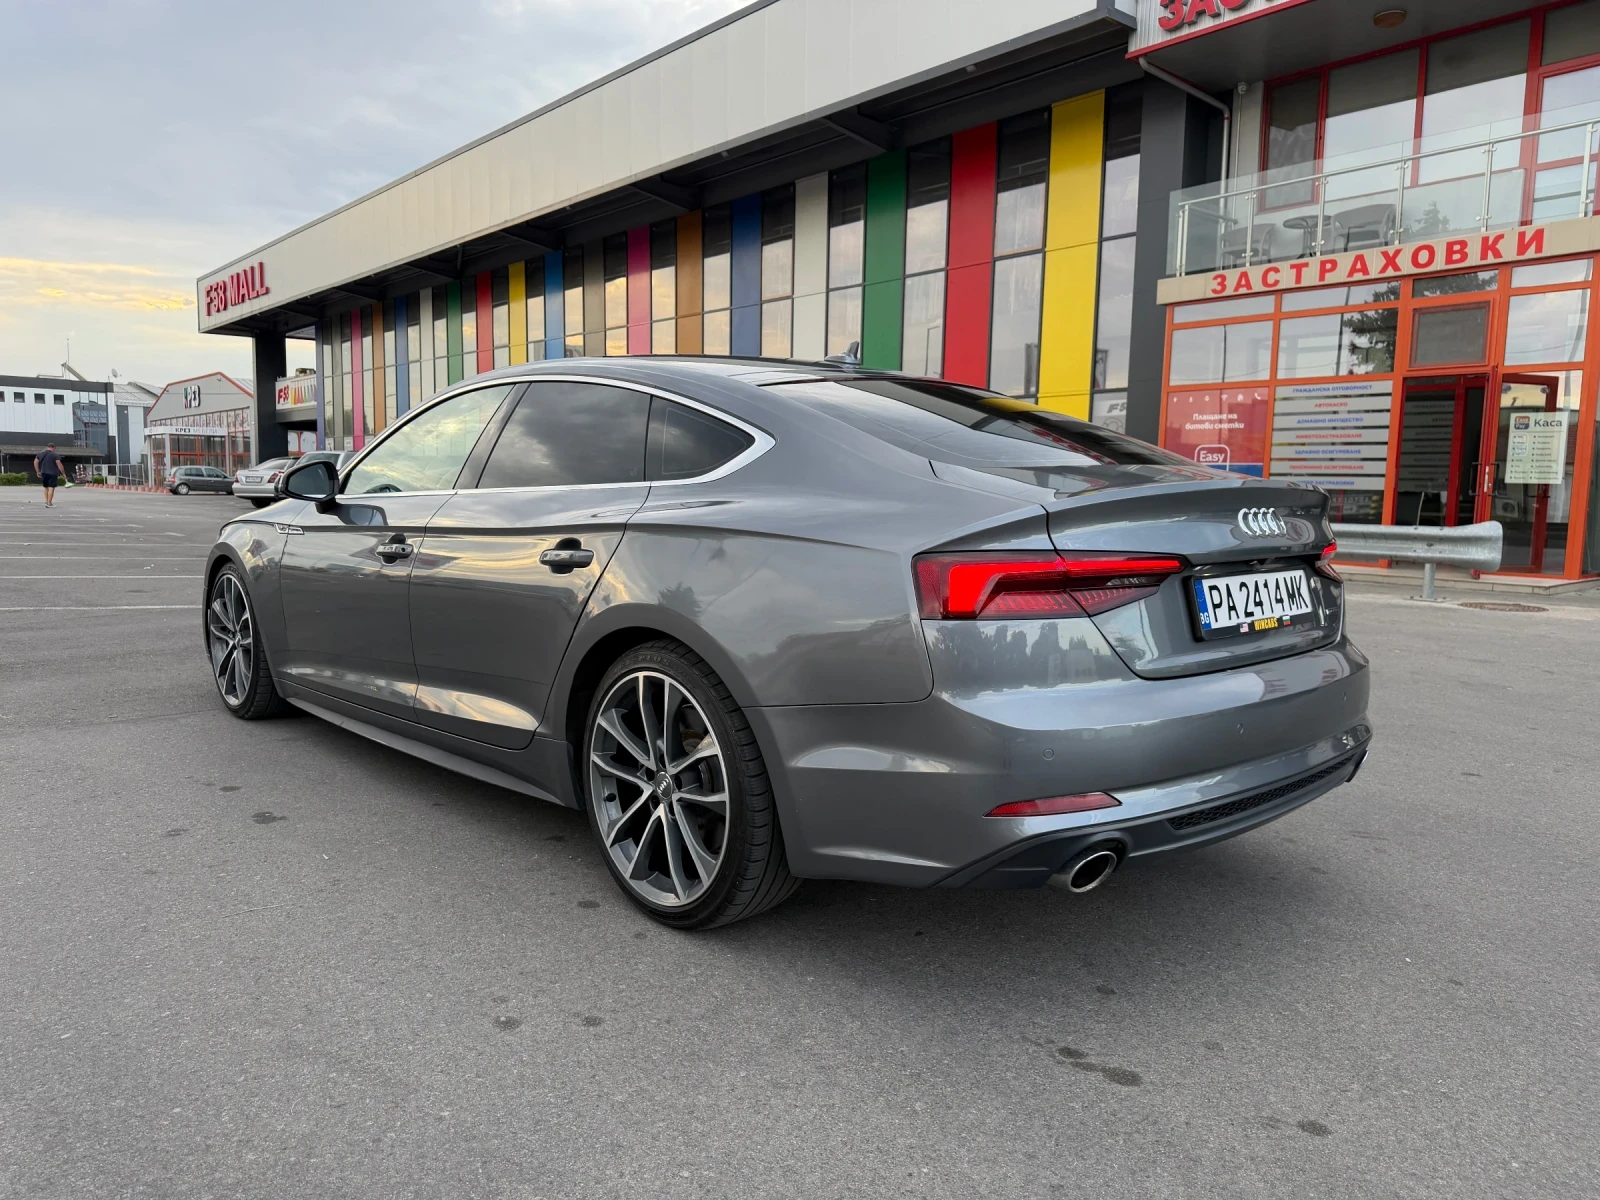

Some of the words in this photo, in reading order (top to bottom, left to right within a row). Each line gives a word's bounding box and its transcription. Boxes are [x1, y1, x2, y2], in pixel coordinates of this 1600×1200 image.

[1211, 228, 1545, 295] ЗАСТРАХОВКИ
[205, 280, 228, 316] F58
[229, 262, 270, 306] MALL
[1193, 413, 1227, 421] Плащане
[1534, 418, 1563, 427] Каса
[1185, 422, 1214, 430] битови
[1199, 450, 1225, 463] Easy
